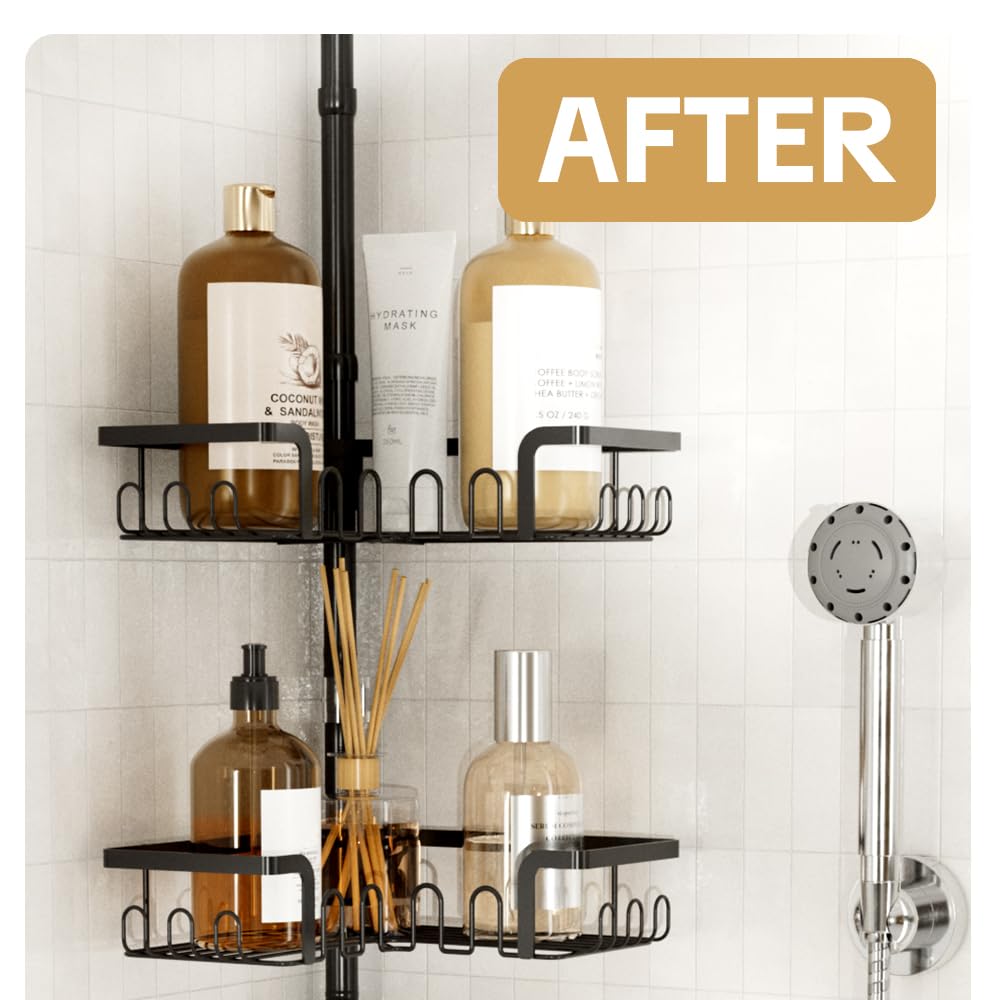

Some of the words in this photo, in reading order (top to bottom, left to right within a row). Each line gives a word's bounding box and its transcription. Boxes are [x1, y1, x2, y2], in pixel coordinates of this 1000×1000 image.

[384, 321, 417, 331] MASK
[536, 368, 566, 377] OFFEE
[536, 379, 566, 388] OFFEE
[534, 389, 554, 398] HEA
[556, 389, 584, 398] BUTTER
[270, 393, 317, 405] COCONUT
[264, 406, 273, 416] &
